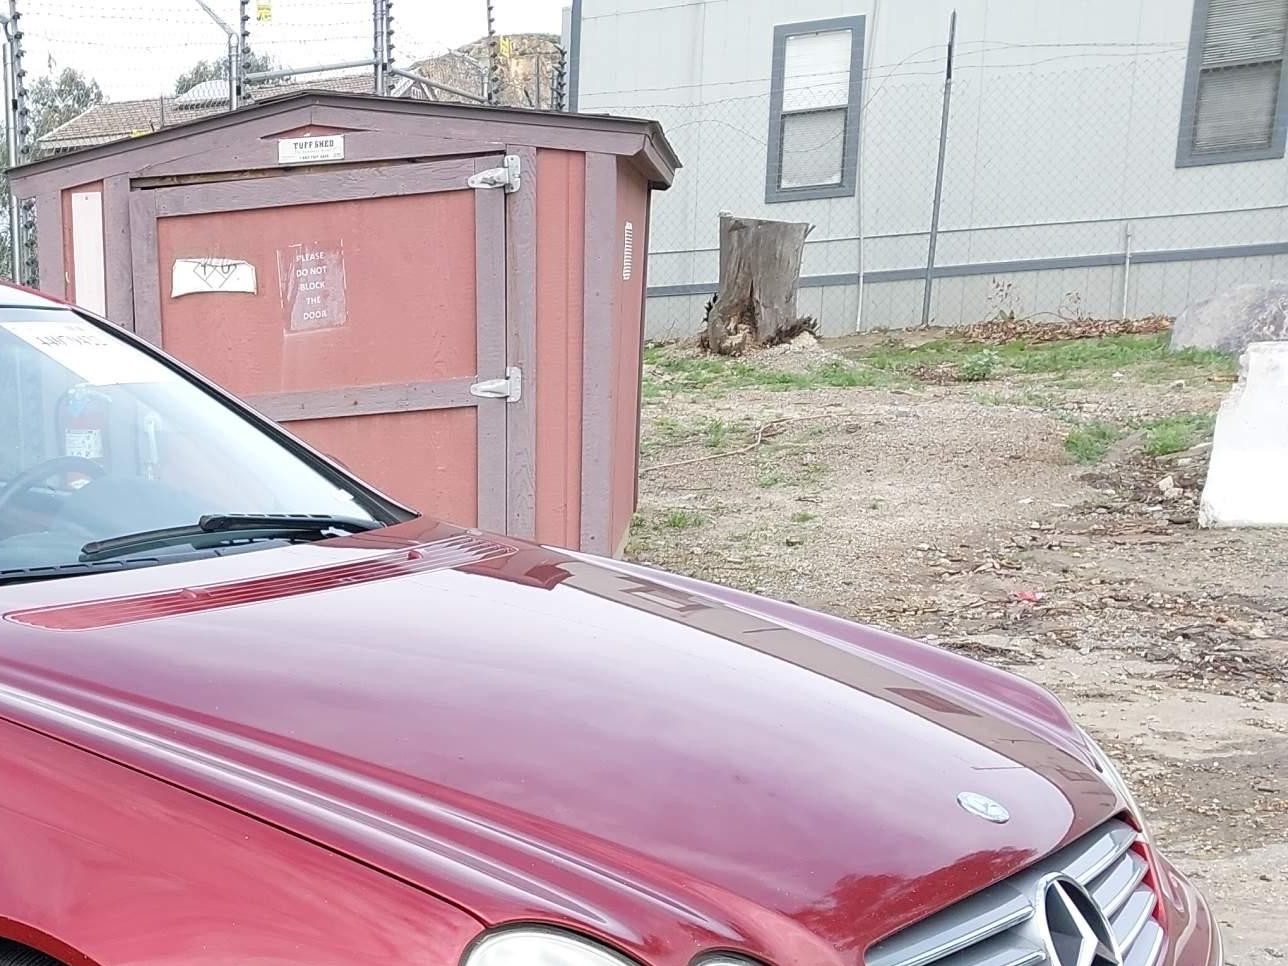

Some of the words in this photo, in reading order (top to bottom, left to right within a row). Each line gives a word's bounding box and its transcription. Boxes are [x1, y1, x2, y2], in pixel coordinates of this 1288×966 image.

[292, 141, 313, 150] TUFF
[314, 139, 334, 149] SHED
[296, 251, 325, 263] PLEASE
[296, 269, 309, 278] DO
[310, 266, 327, 276] NOT
[300, 281, 325, 291] BLOCK
[306, 296, 321, 305] THE
[303, 310, 328, 320] DOOR
